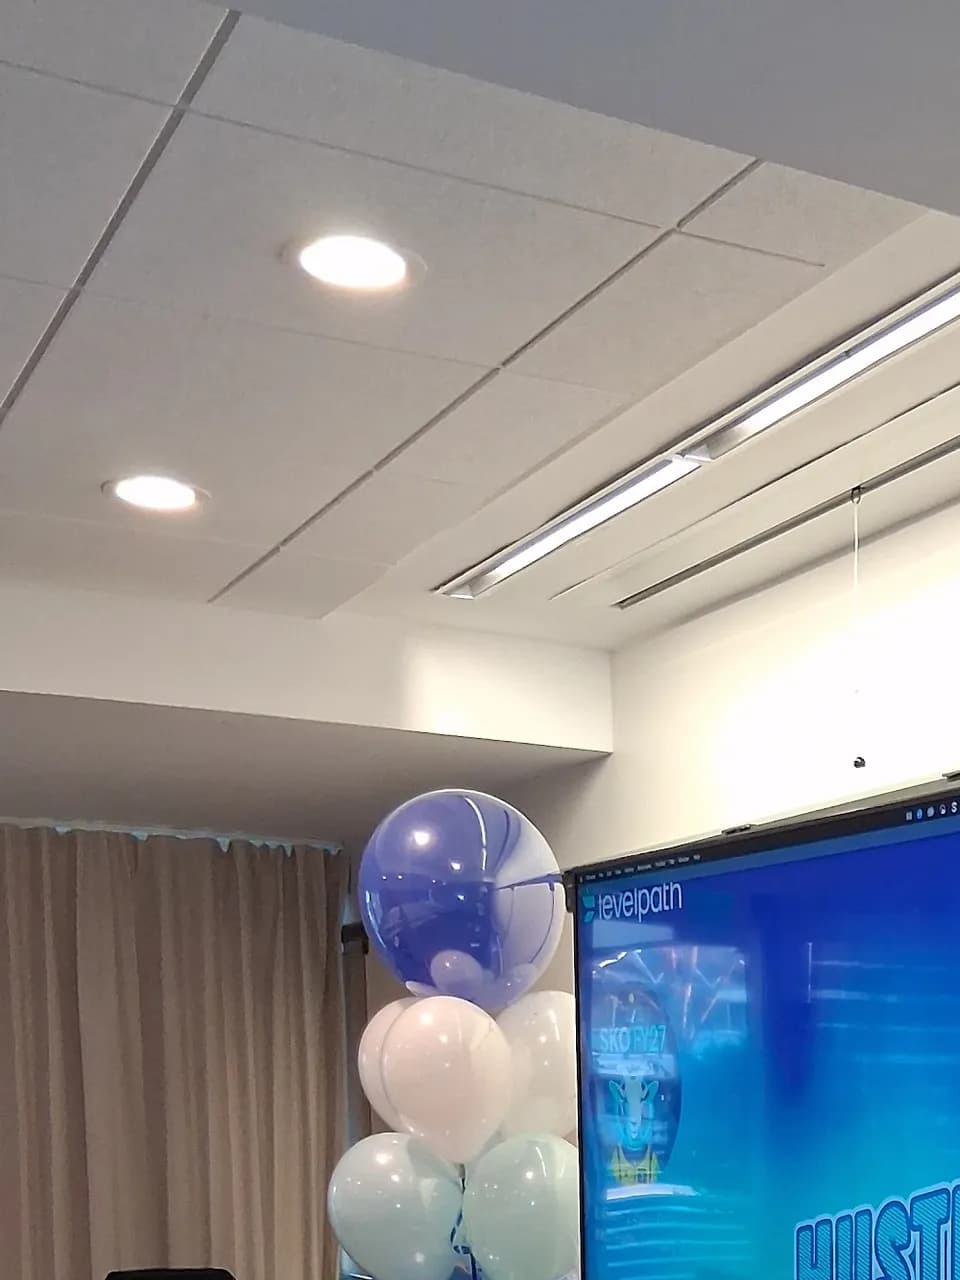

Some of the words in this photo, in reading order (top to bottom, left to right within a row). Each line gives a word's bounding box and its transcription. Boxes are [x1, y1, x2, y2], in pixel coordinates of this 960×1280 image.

[598, 881, 682, 923] levelpath
[600, 1026, 630, 1053] SKO
[632, 1024, 666, 1052] FY27
